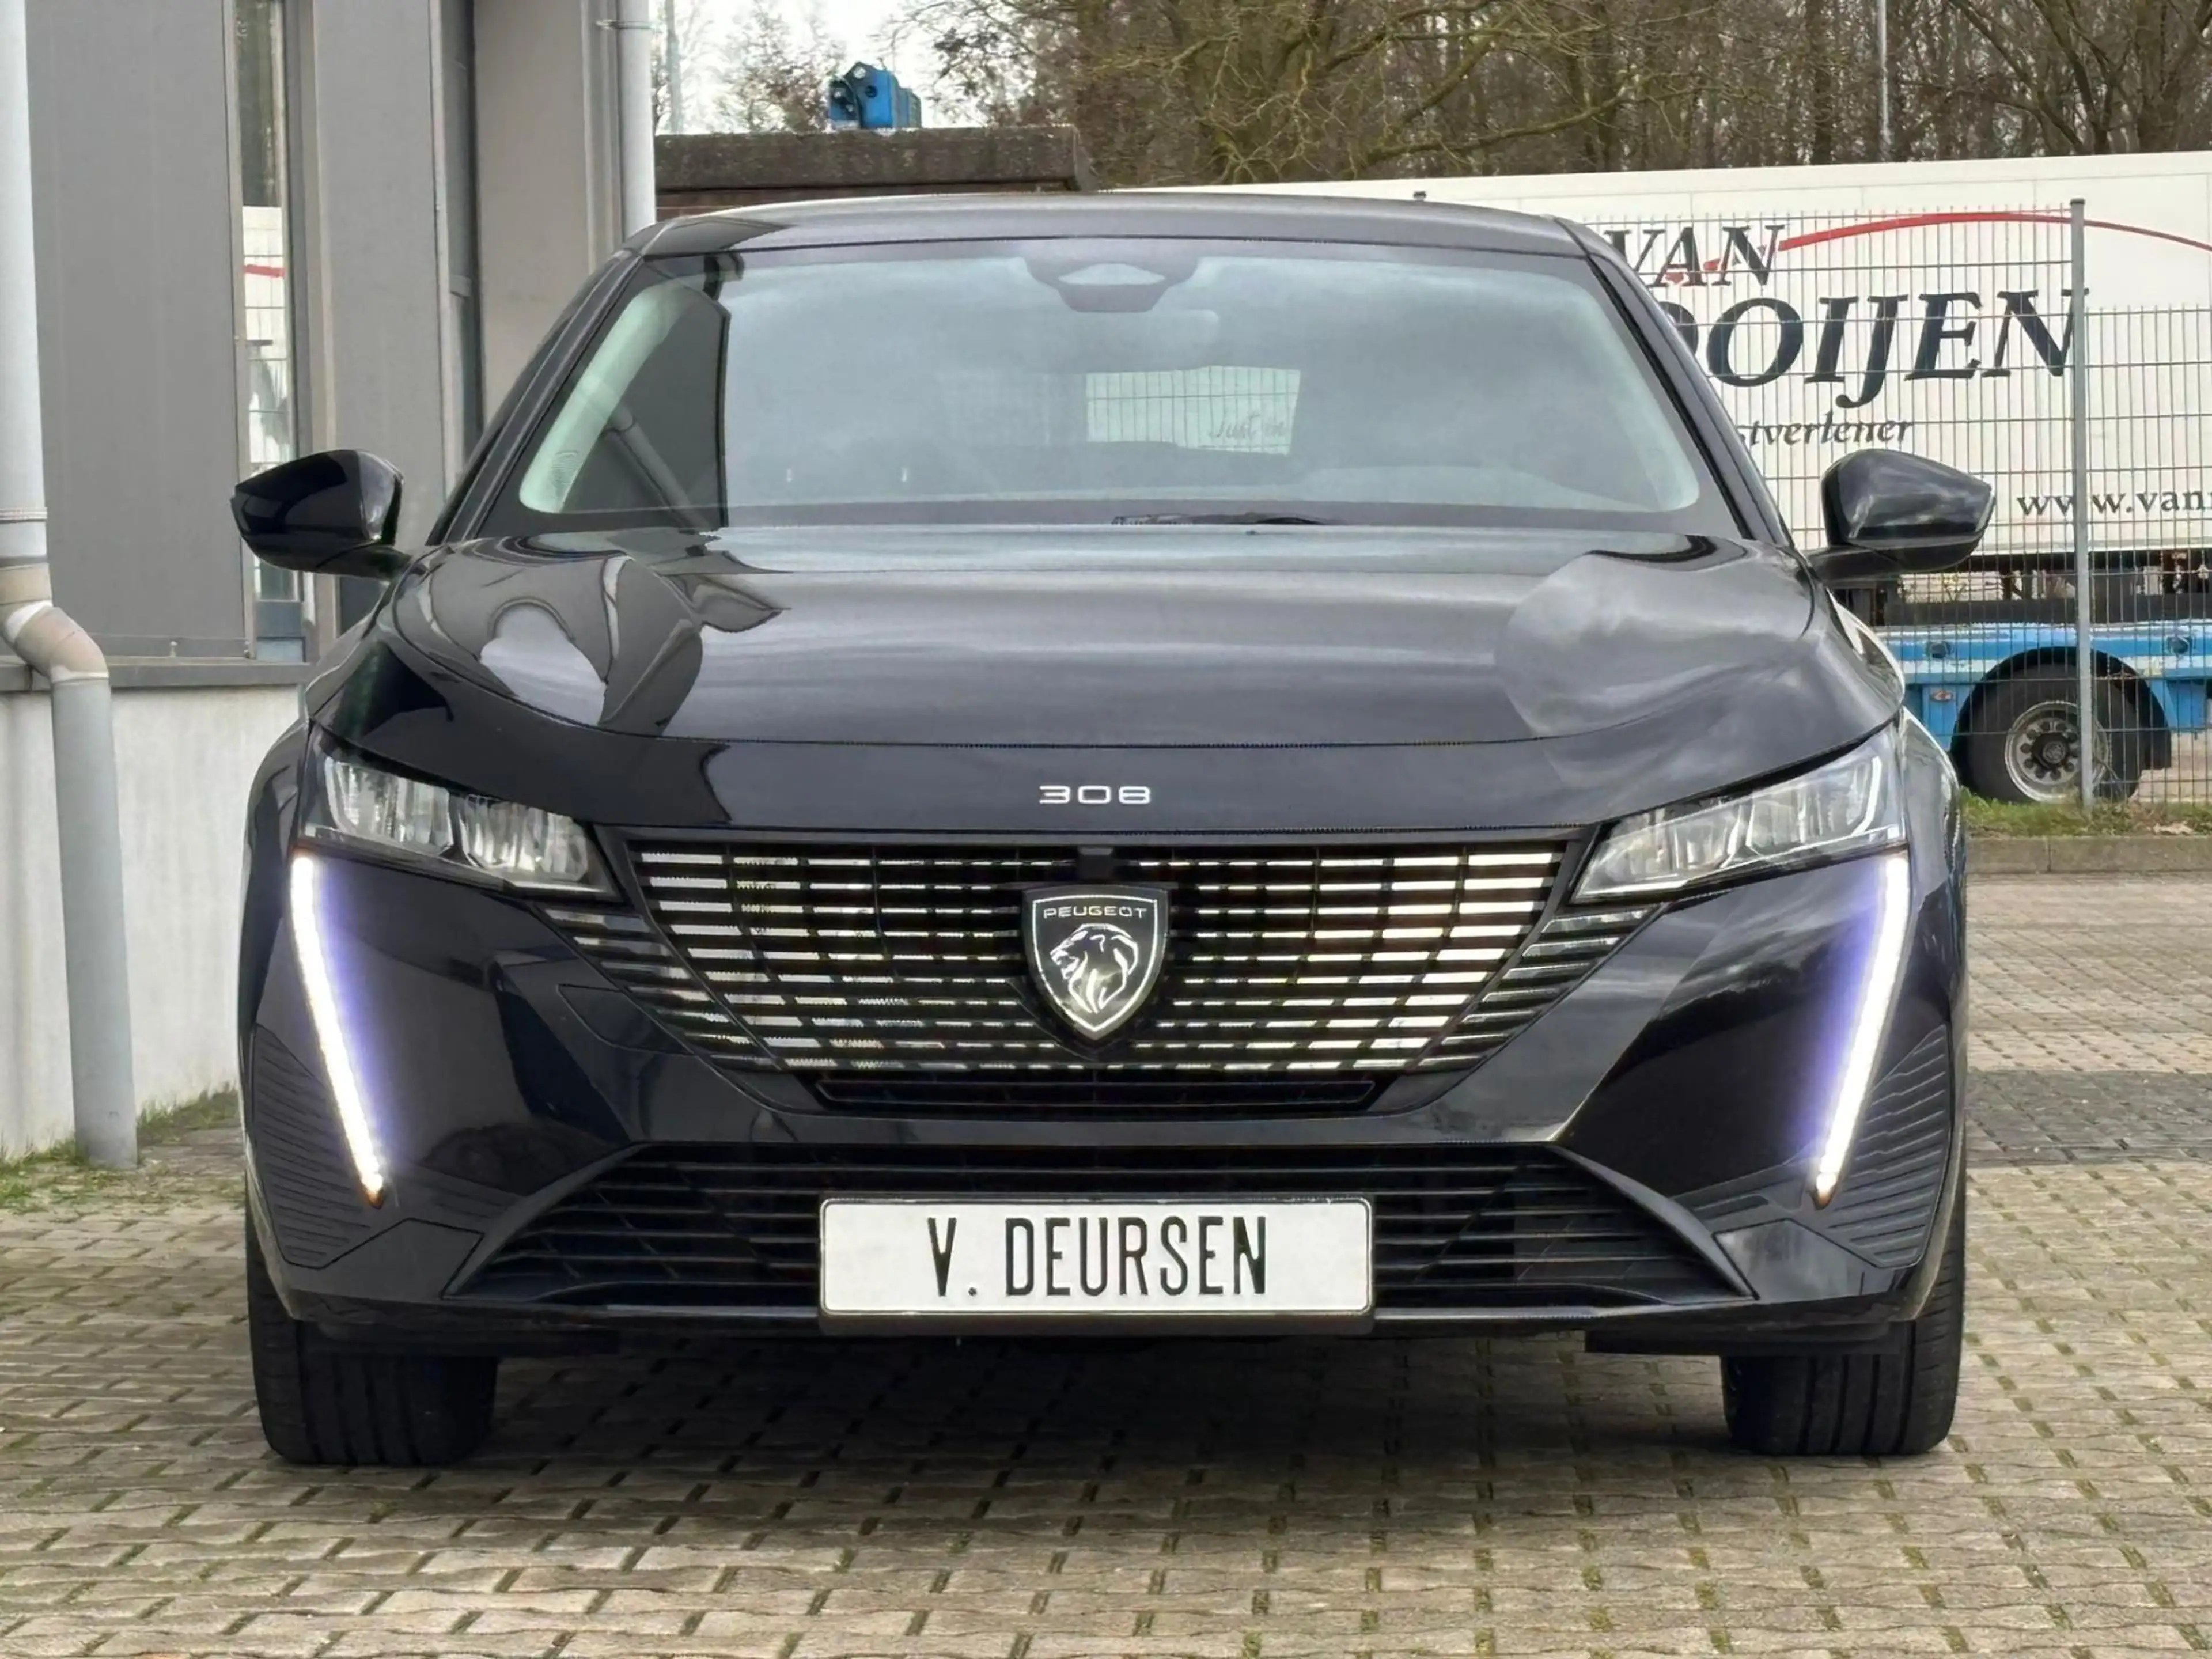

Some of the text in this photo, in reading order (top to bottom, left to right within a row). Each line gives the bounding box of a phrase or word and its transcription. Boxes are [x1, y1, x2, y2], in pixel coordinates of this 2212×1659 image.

[1604, 225, 1785, 287] VAN
[2016, 490, 2212, 517] www.van
[1039, 785, 1151, 804] 308
[1043, 905, 1147, 919] PEUGEOT
[927, 1215, 1266, 1297] V. DEURSEN
